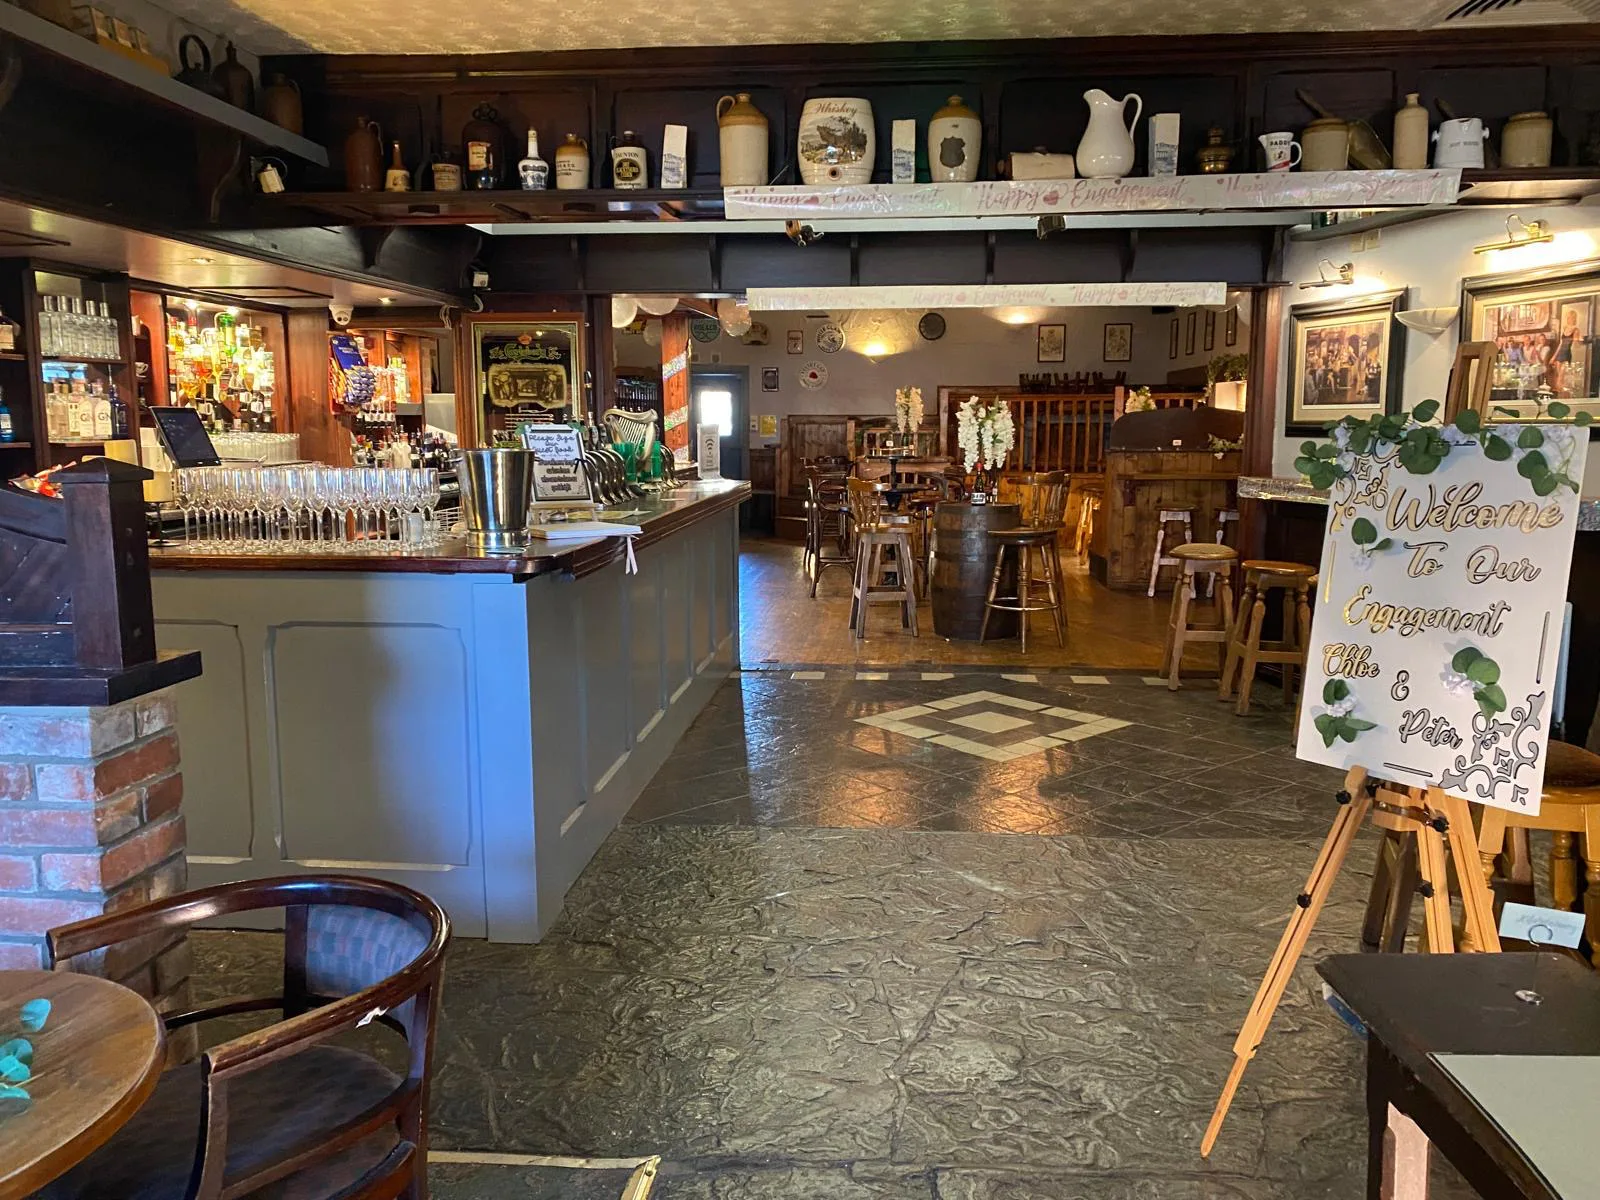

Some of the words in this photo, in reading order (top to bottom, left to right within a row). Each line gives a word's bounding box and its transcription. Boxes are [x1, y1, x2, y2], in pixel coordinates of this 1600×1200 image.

[815, 102, 858, 118] Whiskey
[977, 184, 1041, 210] Happy
[1068, 178, 1186, 208] Engagement
[1134, 284, 1221, 303] Engageme
[1385, 479, 1564, 533] Welcome
[1403, 541, 1449, 578] To
[1465, 544, 1543, 584] Our
[1342, 584, 1512, 639] Engagement
[1321, 643, 1381, 679] Chloe
[1389, 670, 1411, 702] &
[1399, 708, 1463, 750] Peter
